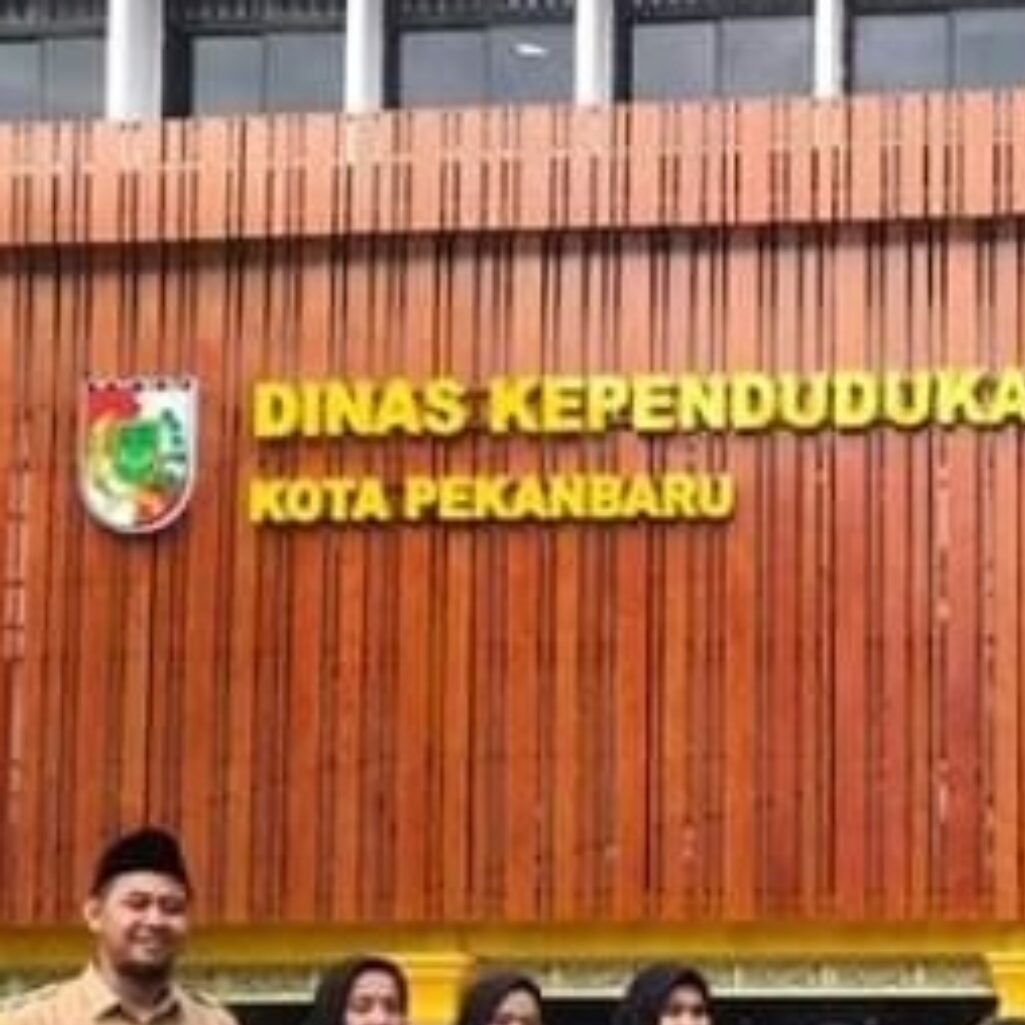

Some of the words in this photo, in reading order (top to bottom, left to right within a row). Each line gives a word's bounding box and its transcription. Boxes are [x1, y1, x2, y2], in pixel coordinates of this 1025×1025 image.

[252, 378, 468, 440] DINAS
[249, 478, 390, 524] KOTA
[404, 472, 735, 522] PEKANBARU
